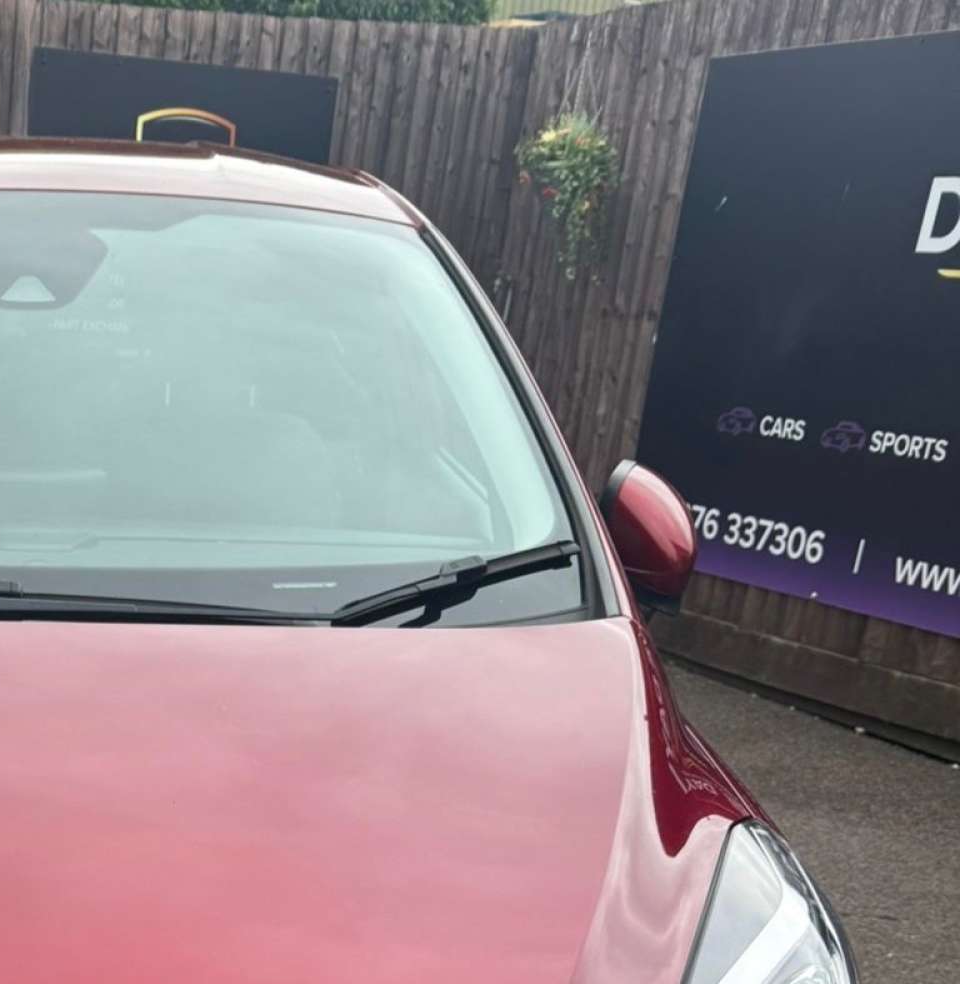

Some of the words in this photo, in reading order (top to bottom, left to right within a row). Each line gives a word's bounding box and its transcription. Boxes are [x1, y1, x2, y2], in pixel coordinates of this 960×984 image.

[759, 415, 806, 441] CARS
[869, 430, 948, 462] SPORTS
[723, 512, 826, 564] 337306
